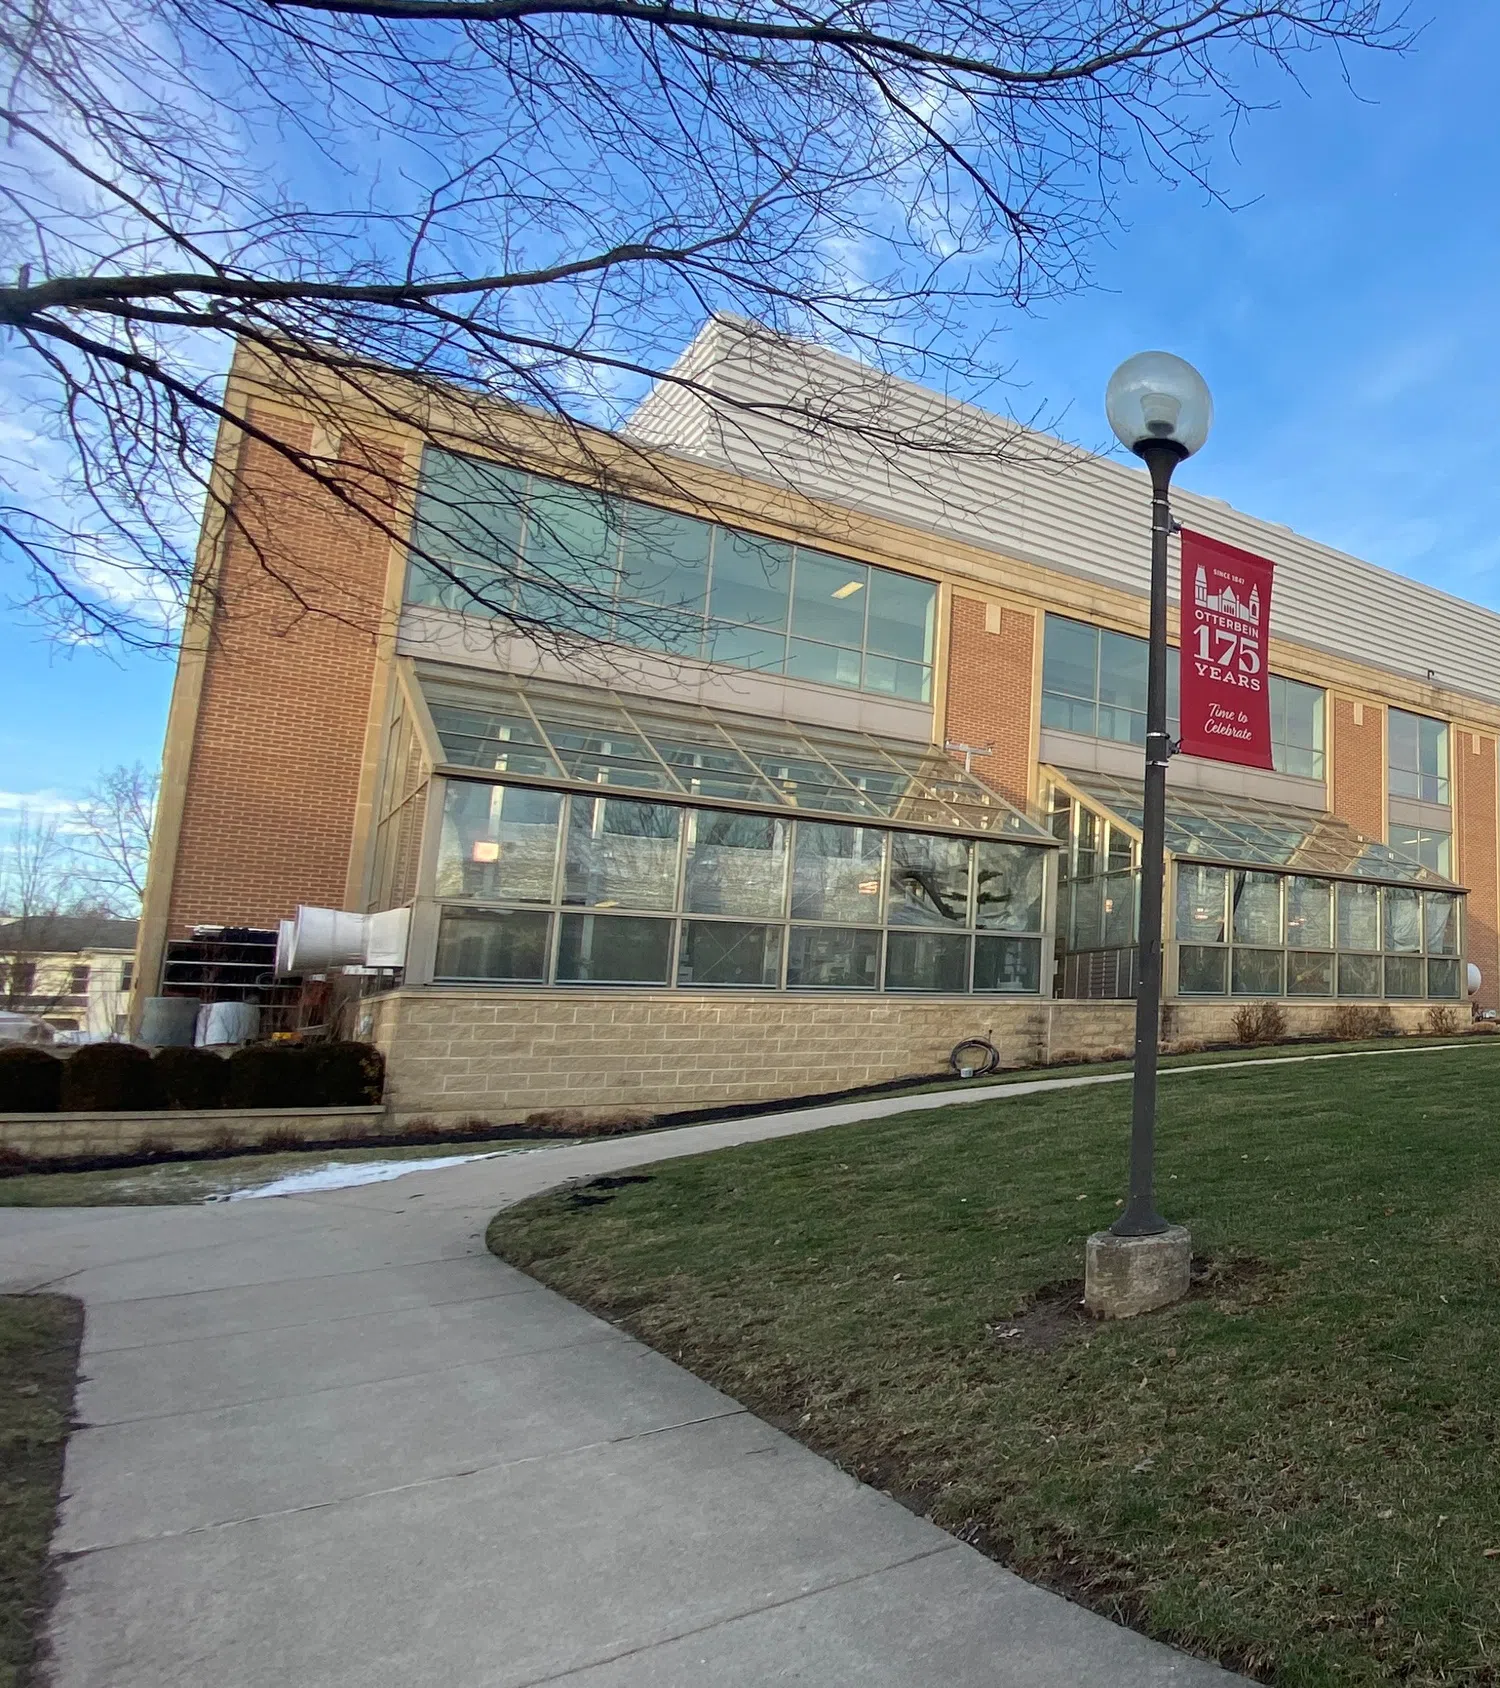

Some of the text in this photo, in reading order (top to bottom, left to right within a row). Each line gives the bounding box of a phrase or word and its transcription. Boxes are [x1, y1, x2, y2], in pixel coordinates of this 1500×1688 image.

[1213, 568, 1230, 580] SINCE
[1195, 609, 1259, 639] OTTERBEIN
[1193, 624, 1260, 674] 175
[1195, 662, 1260, 691] YEARS
[1209, 703, 1248, 723] Time to
[1204, 719, 1252, 740] Celebrate
